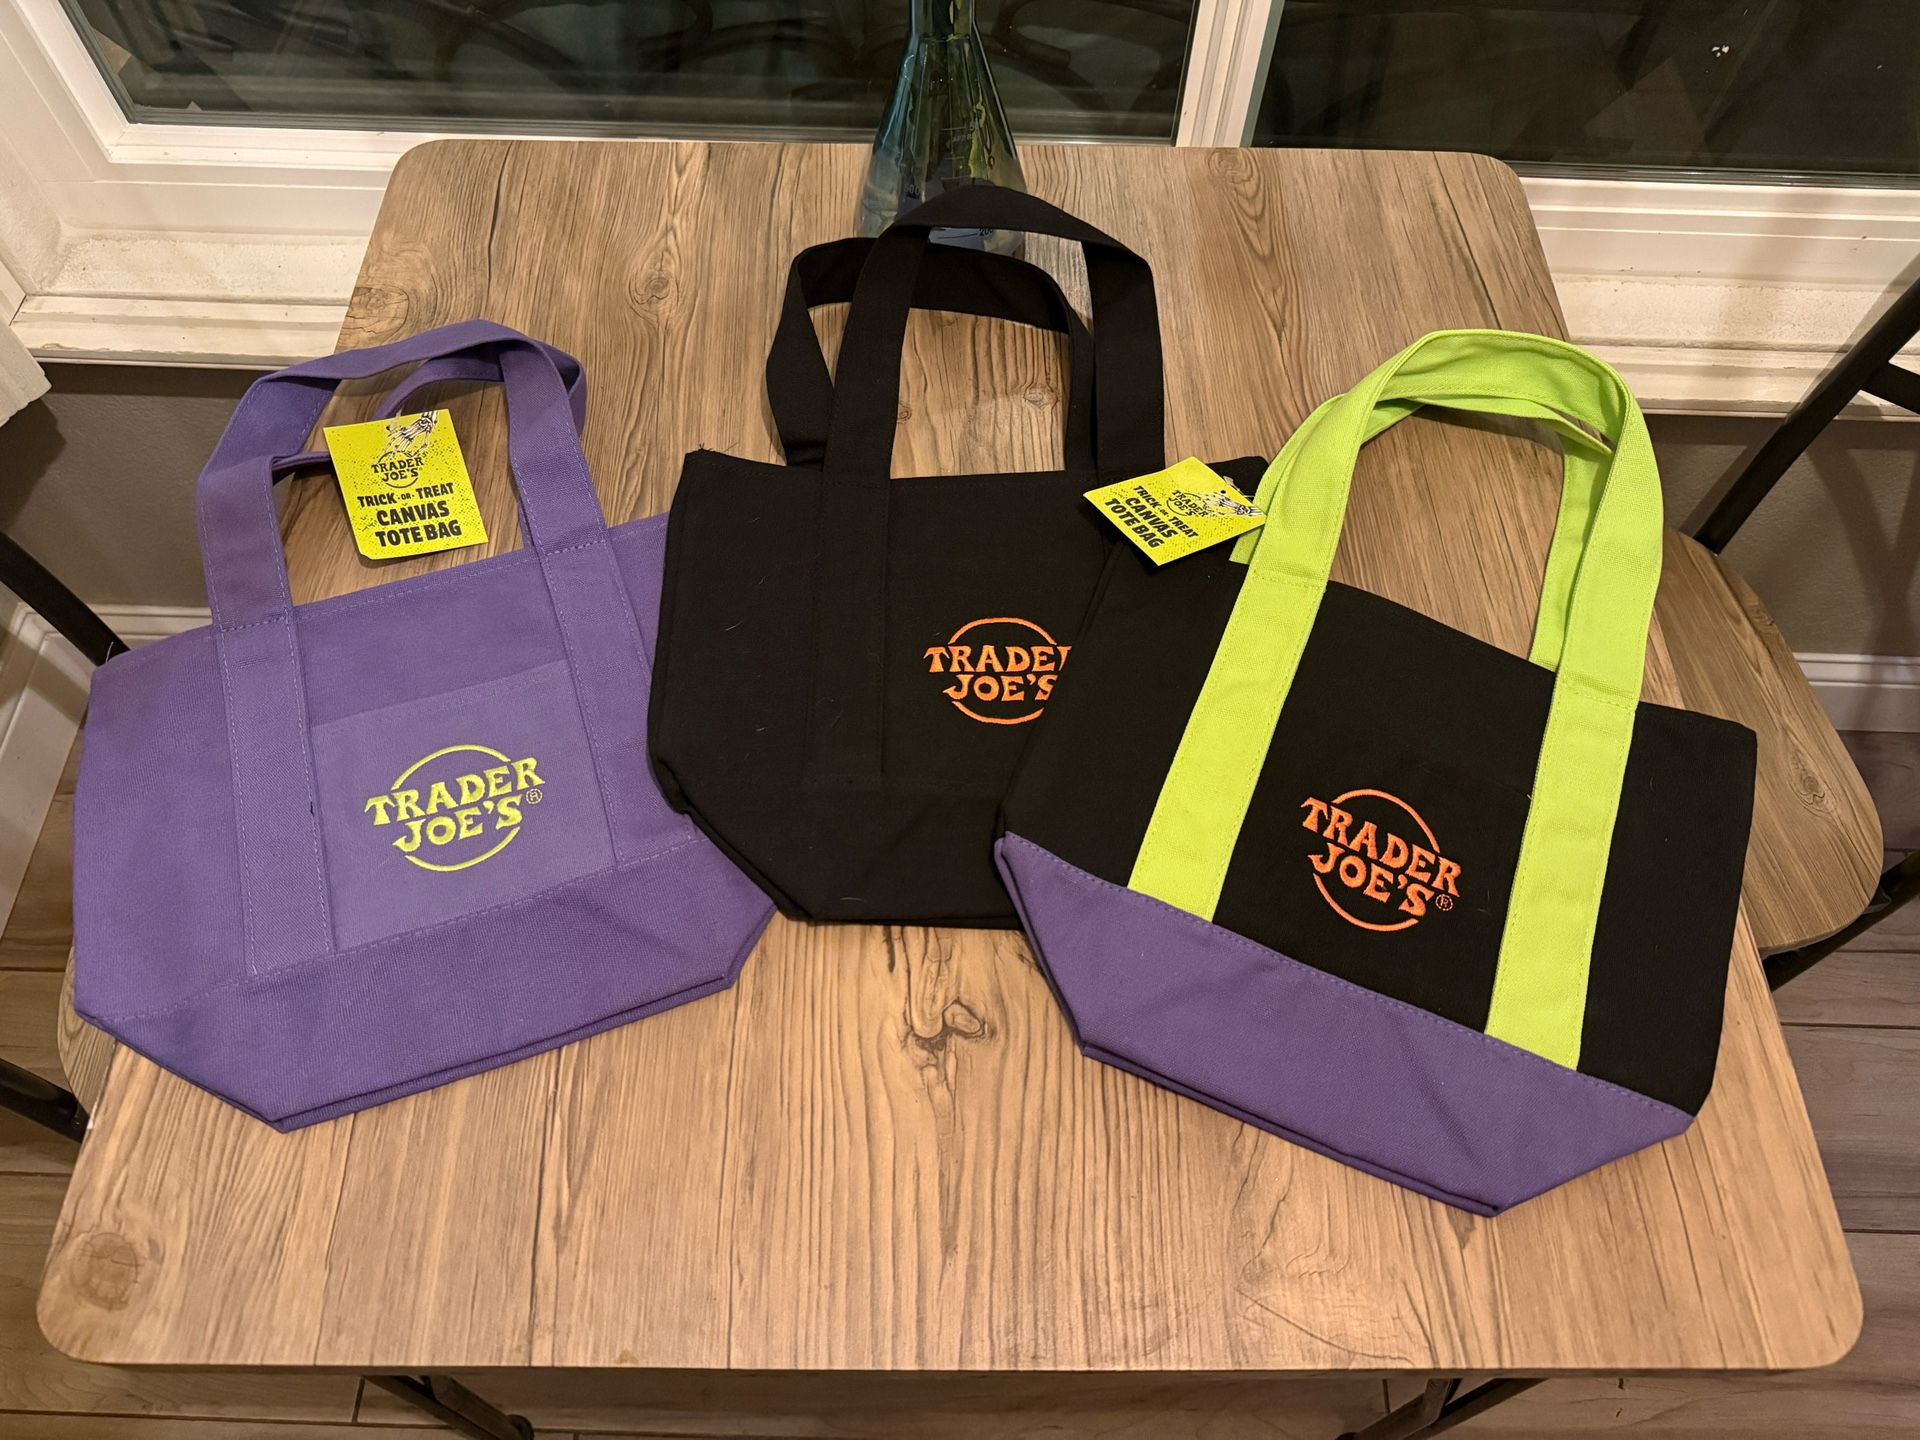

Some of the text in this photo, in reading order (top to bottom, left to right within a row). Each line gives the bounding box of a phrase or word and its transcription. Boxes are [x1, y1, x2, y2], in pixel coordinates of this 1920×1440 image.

[371, 457, 424, 474] TRADER
[382, 467, 419, 482] JOE'S
[357, 493, 397, 508] TRICK
[416, 482, 454, 499] TREAT
[1169, 497, 1198, 517] JOE'S
[1171, 489, 1209, 518] TRADER
[376, 501, 449, 526] CANVAS
[1105, 498, 1165, 548] TOTE BAG
[1125, 497, 1178, 538] CANVAS
[1133, 485, 1162, 509] TRICK
[1168, 516, 1199, 538] TREAT
[375, 520, 462, 547] TOTE BAG
[942, 674, 1059, 702] JOE'S
[364, 757, 546, 826] TRADER
[392, 794, 523, 853] JOE'S
[1300, 796, 1462, 898] TRADER
[1307, 842, 1435, 917] JOE'S
